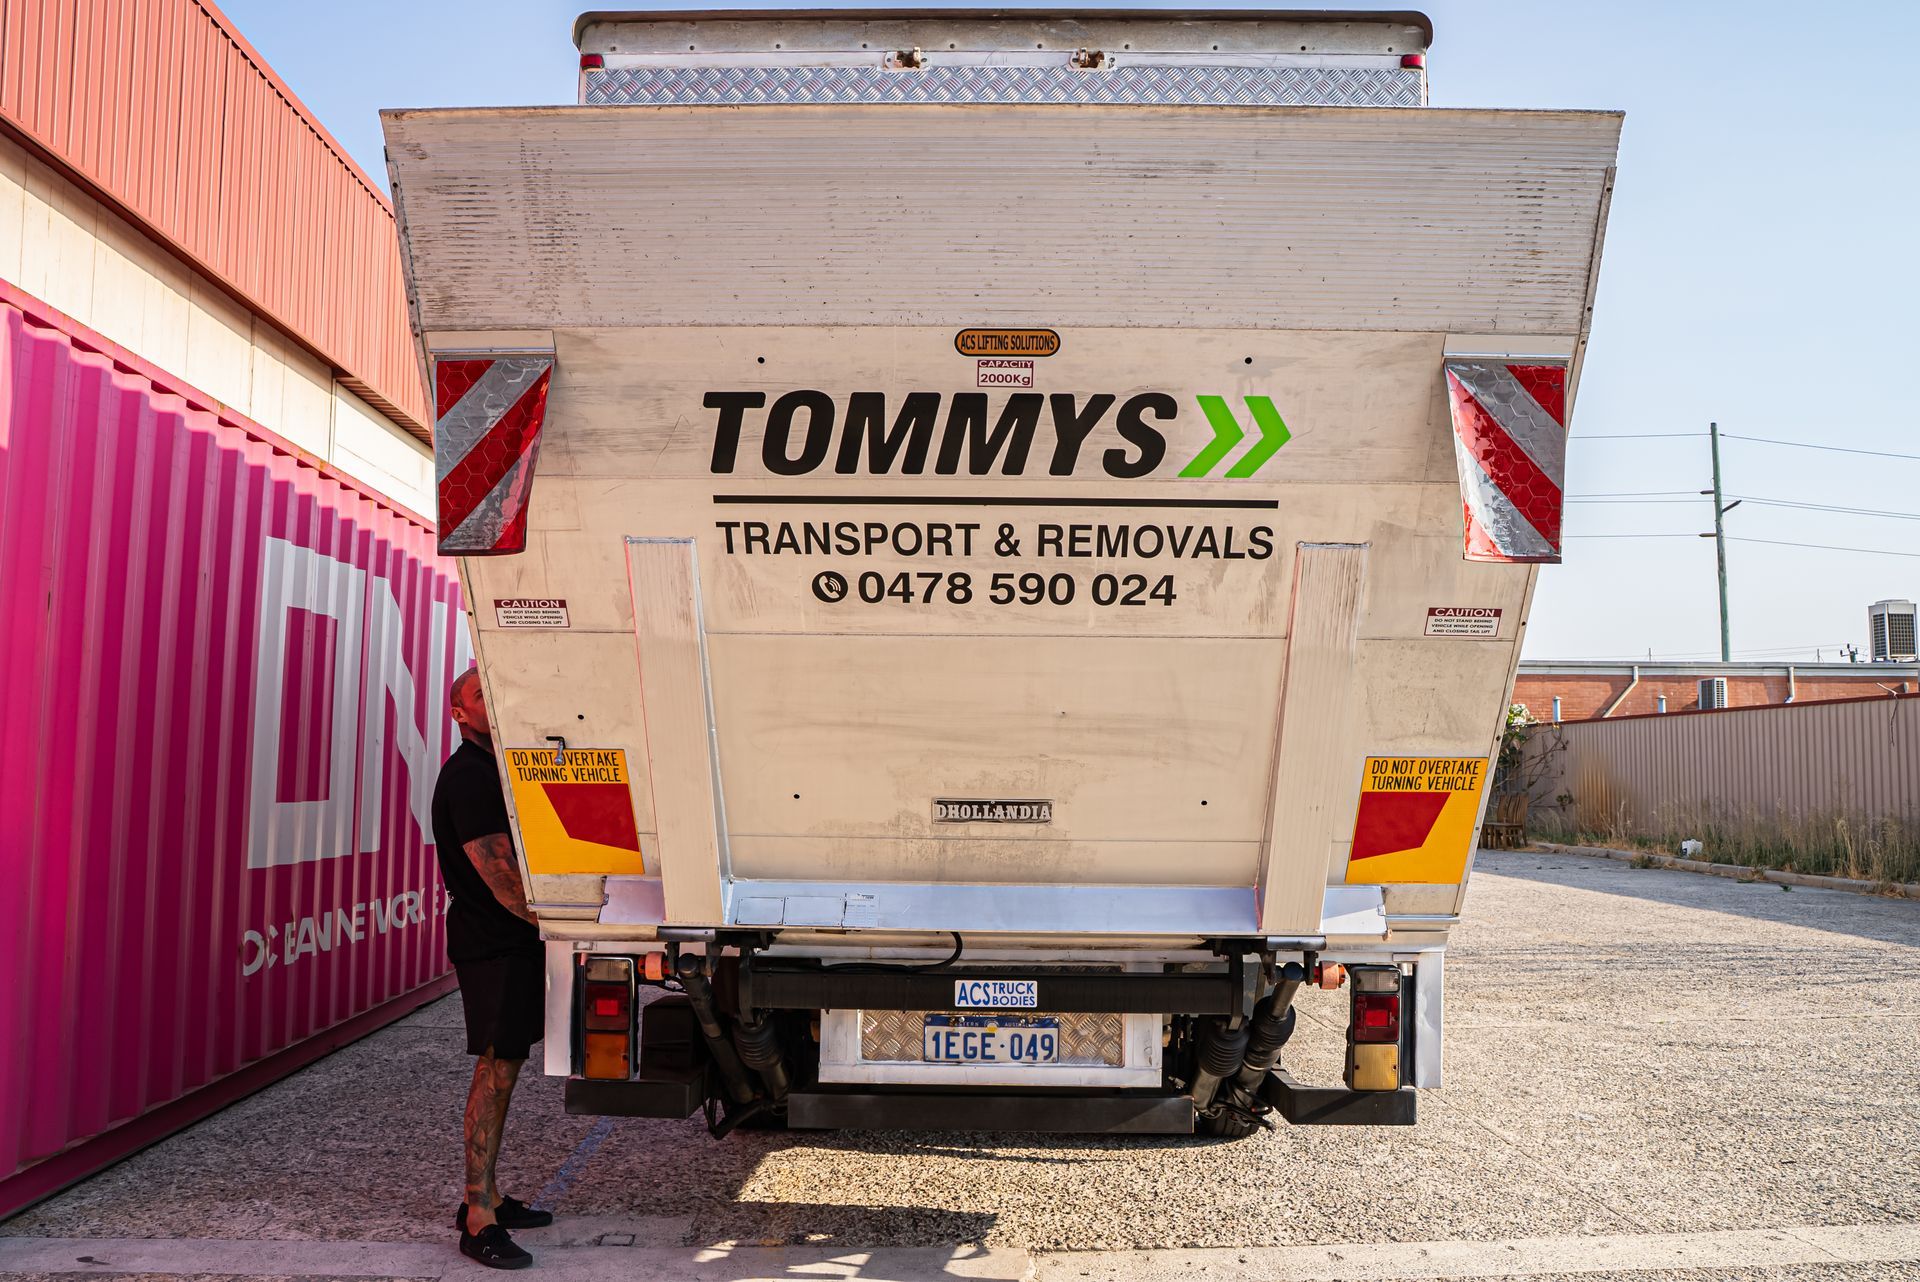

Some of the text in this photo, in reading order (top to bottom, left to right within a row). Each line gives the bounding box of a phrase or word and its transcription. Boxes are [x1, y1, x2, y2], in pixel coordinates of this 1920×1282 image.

[960, 335, 1055, 351] ACS LIFTING SOLUTIONS
[978, 360, 1032, 368] CAPACITY
[980, 373, 1031, 386] 2000Kg
[702, 390, 1177, 478] TOMMYS
[716, 521, 1274, 560] TRANSPORT & REMOVALS
[858, 571, 1177, 607] 0478 590 024
[501, 600, 559, 608] CAUTION
[1435, 608, 1495, 617] CAUTION
[512, 752, 528, 766] DO
[531, 752, 553, 766] NOT
[1371, 760, 1480, 775] DO NOT OVERTAKE
[517, 768, 622, 782] TURNING VEHICLE
[1372, 776, 1477, 790] TURNING VEHICLE
[936, 804, 1050, 820] DHOLLANDIA
[957, 982, 1034, 1006] ACS TRUCK
[992, 996, 1035, 1006] BODIES
